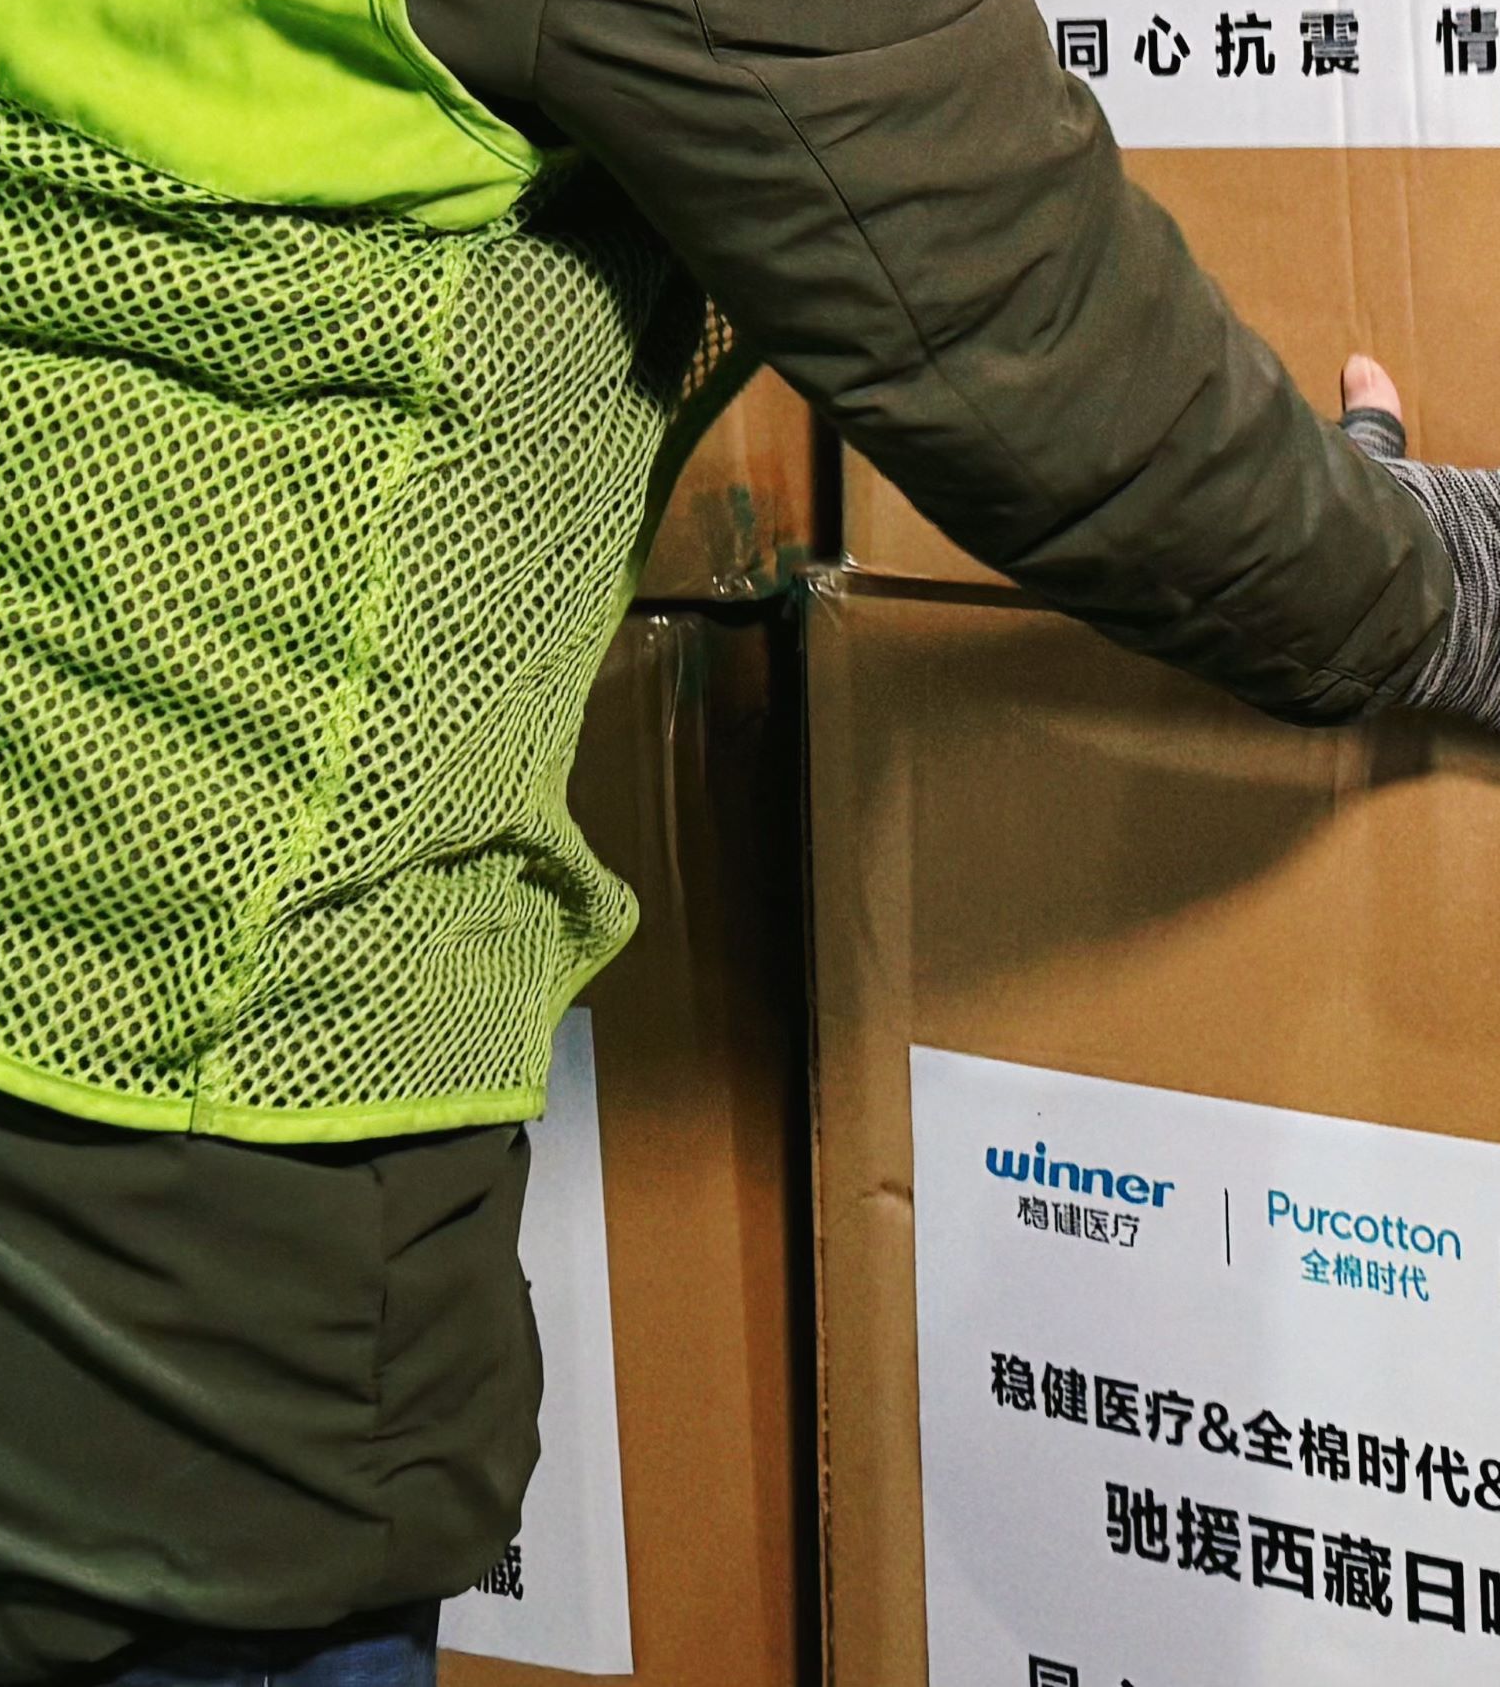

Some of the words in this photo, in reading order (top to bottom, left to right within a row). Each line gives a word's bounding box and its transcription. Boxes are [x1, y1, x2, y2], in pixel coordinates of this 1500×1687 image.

[1056, 12, 1360, 78] 同心抗震
[985, 1141, 1175, 1210] winner
[1017, 1195, 1140, 1248] 稳健医疗
[1267, 1189, 1462, 1261] Purcotton
[1300, 1249, 1430, 1302] 全棉时代
